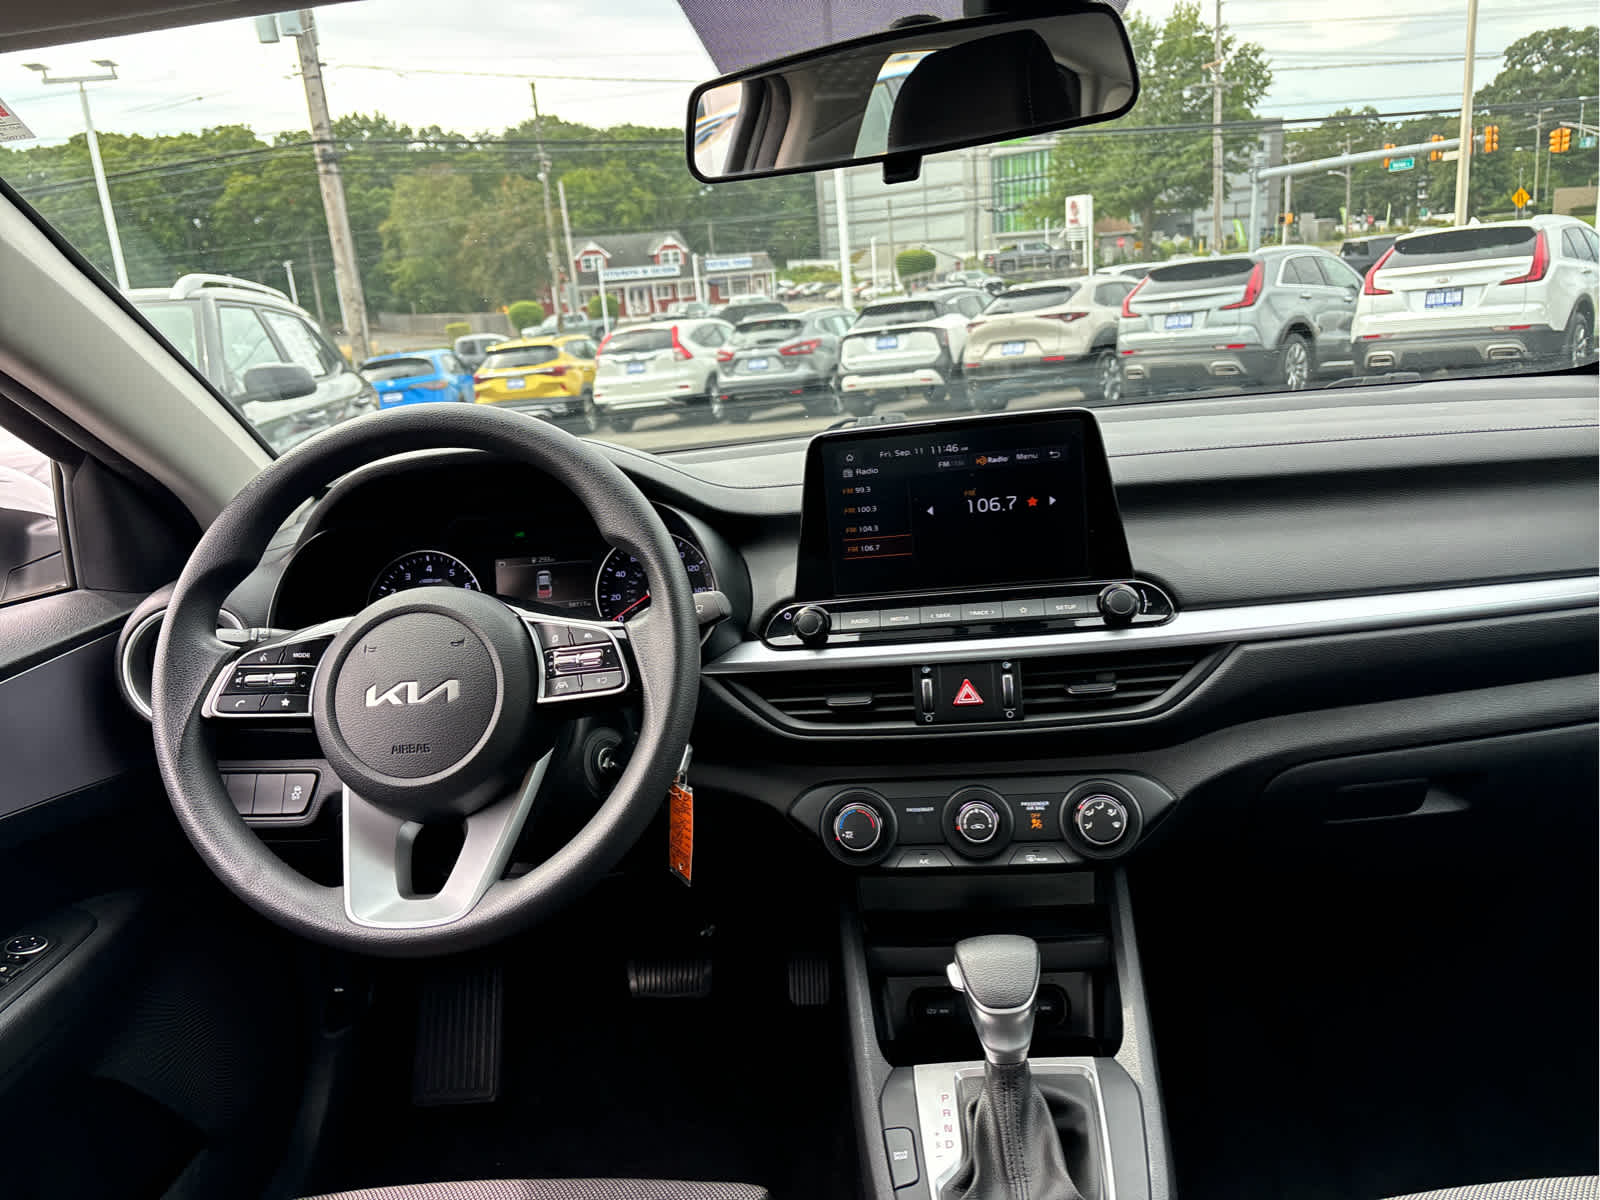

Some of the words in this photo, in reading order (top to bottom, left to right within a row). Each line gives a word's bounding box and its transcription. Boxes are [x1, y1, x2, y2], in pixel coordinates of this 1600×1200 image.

[930, 443, 959, 455] 11:46
[1015, 451, 1039, 460] Menu
[855, 467, 879, 476] Radio
[967, 495, 1017, 513] 106.7
[857, 505, 877, 513] 100.3
[861, 544, 880, 552] 106.7
[687, 564, 700, 572] 120
[405, 573, 411, 581] 3
[449, 569, 455, 577] 5
[615, 570, 626, 578] 40
[610, 593, 621, 601] 20
[391, 743, 431, 755] AIRBAG
[941, 1094, 949, 1103] P
[942, 1108, 952, 1117] R
[943, 1123, 953, 1133] N
[945, 1139, 954, 1150] D
